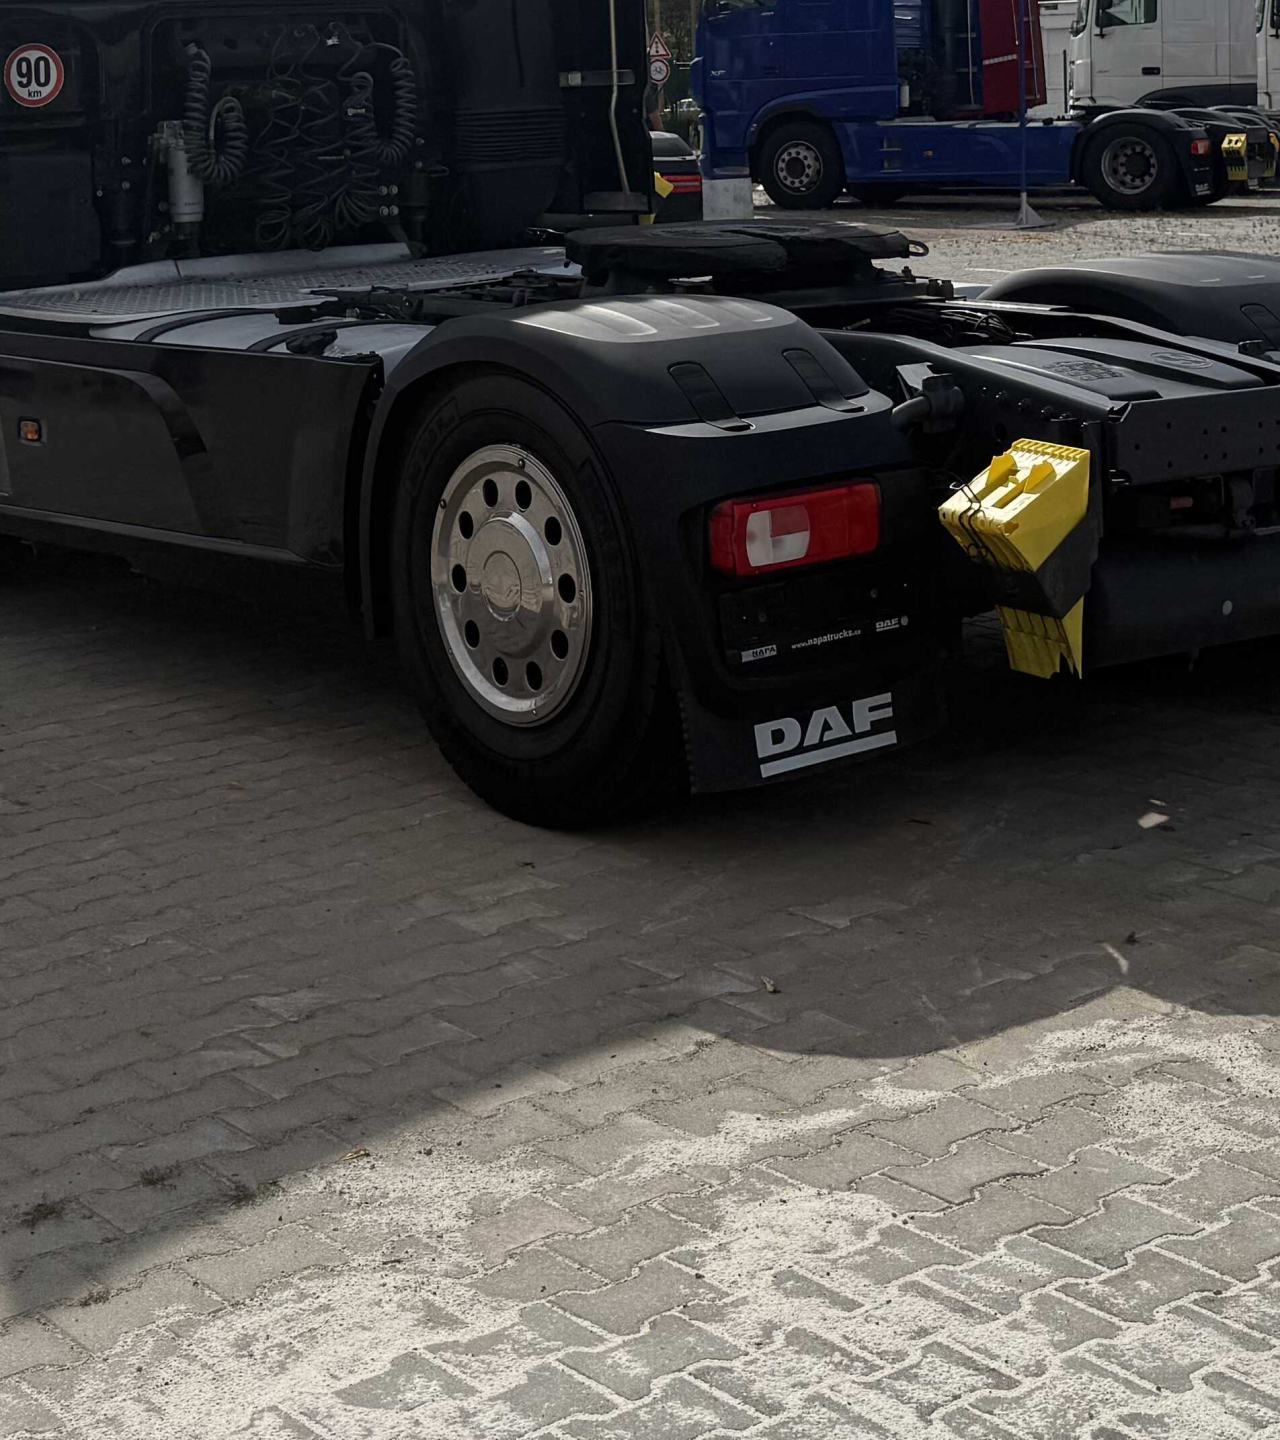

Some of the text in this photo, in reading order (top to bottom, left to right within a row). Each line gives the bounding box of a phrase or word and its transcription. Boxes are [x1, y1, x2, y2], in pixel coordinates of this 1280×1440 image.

[16, 56, 51, 89] 90
[27, 89, 42, 98] km
[875, 617, 899, 629] DAF
[753, 691, 894, 760] DAF
